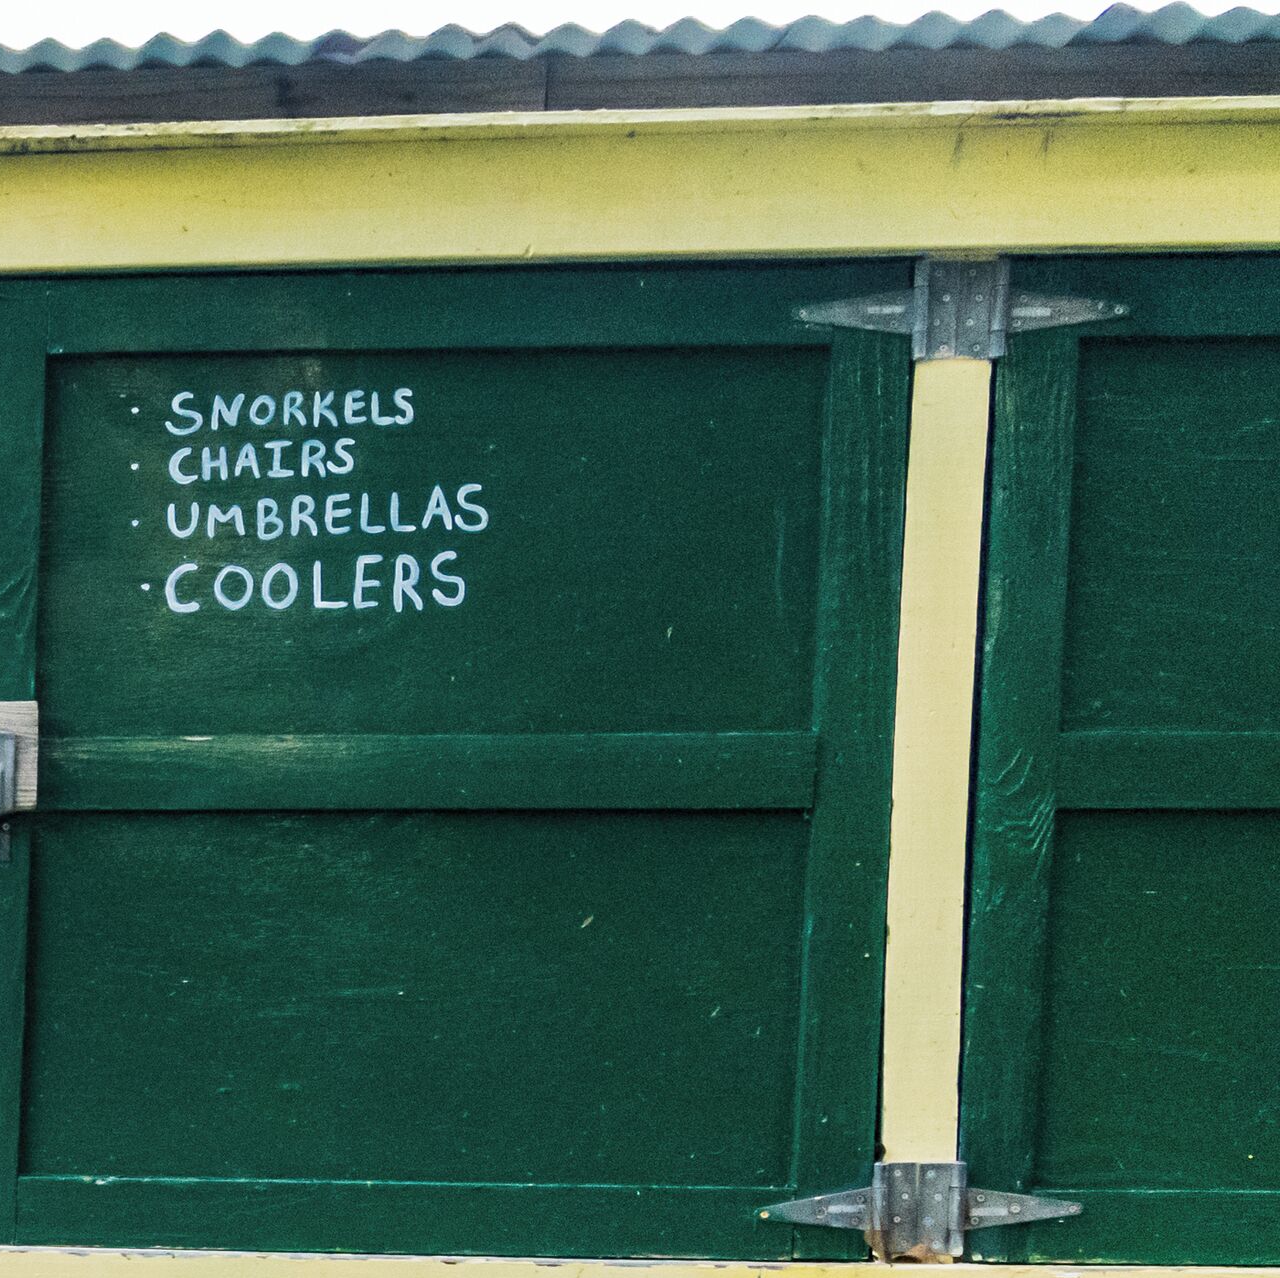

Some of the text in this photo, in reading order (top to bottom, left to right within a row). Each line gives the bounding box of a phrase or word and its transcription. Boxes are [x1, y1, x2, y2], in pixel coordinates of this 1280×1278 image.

[164, 388, 415, 437] SNORKELS
[167, 437, 357, 485] CHAIRS
[166, 482, 490, 541] UMBRELLAS
[164, 550, 466, 613] COOLERS
